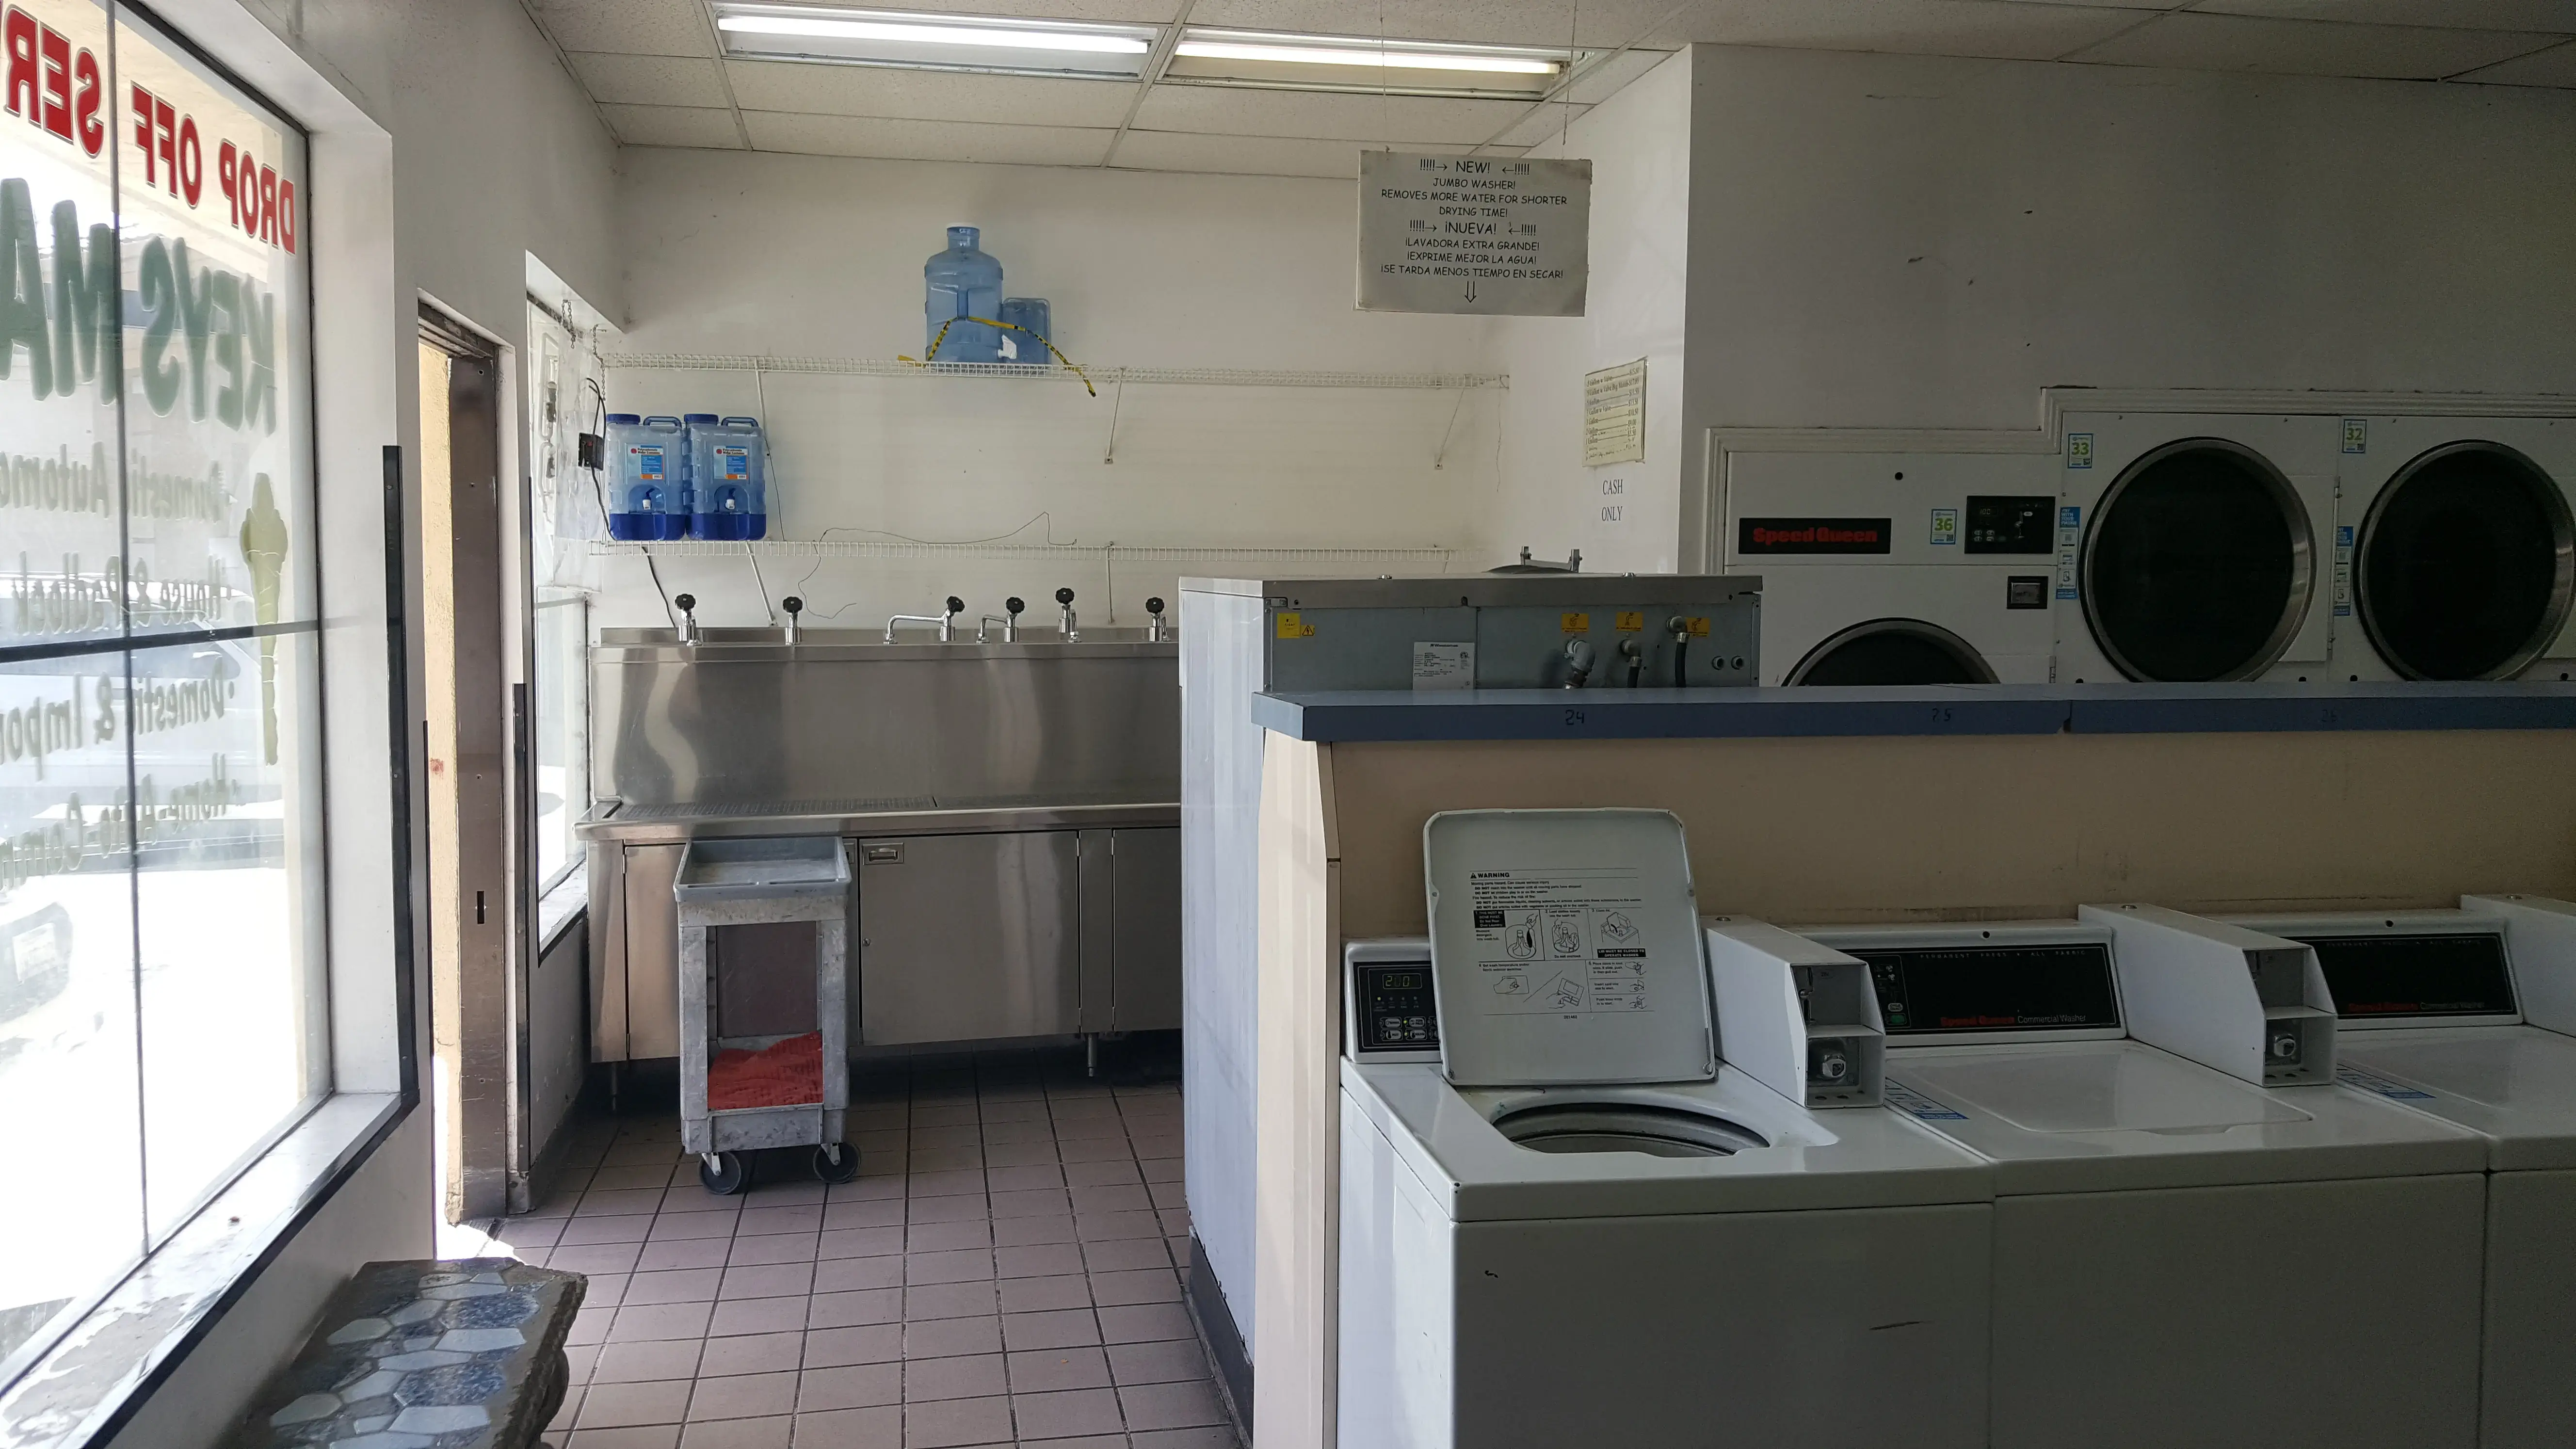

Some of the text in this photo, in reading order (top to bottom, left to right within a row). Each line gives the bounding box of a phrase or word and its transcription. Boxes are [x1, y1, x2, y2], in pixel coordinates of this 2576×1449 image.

[1456, 161, 1490, 174] NEW!
[1433, 177, 1515, 190] JUMBO WASHER!
[1382, 189, 1567, 205] REMOVES MORE WATER FOR SHORTER
[1439, 206, 1508, 217] DRYING TIME!
[1463, 240, 1494, 249] EXTRA
[1497, 241, 1539, 251] GRANDE!
[1455, 254, 1489, 263] MEJOR
[1492, 255, 1503, 264] LA
[1507, 256, 1536, 264] AGUA!
[1399, 265, 1430, 275] TARDA
[1433, 267, 1469, 276] MENOS
[1472, 268, 1510, 278] TIEMPO
[1513, 269, 1527, 278] EN
[1530, 270, 1563, 279] SECAR!
[2346, 428, 2363, 440] 32
[2072, 442, 2089, 455] 33
[1603, 479, 1623, 495] CASH
[1601, 506, 1623, 521] ONLY
[1934, 518, 1953, 531] 36
[1753, 527, 1878, 546] Speed Queen
[1565, 709, 1584, 725] 24
[2017, 1015, 2059, 1024] Commercial
[2060, 1014, 2086, 1023] Washer
